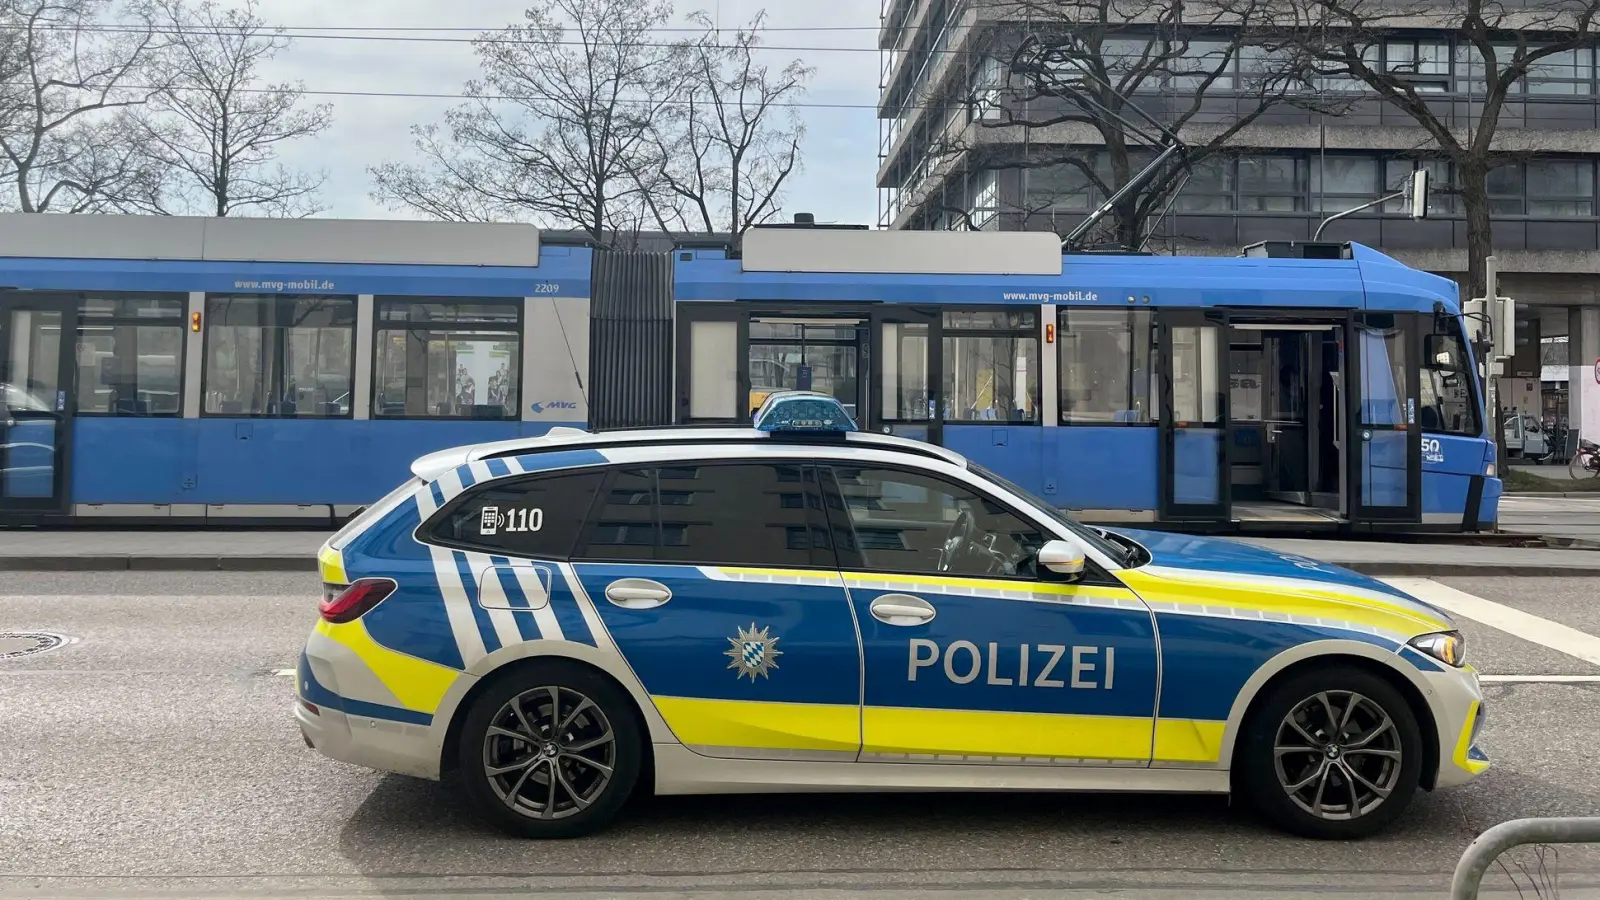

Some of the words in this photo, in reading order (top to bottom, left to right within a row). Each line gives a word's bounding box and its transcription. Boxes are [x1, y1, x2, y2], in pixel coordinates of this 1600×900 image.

[234, 280, 335, 291] www.mvg-mobil.de
[535, 284, 559, 293] 2209
[1003, 291, 1098, 303] www.mvg-mobil.de
[546, 401, 577, 409] MVG
[505, 508, 543, 532] 110
[907, 638, 1115, 690] POLIZEI
